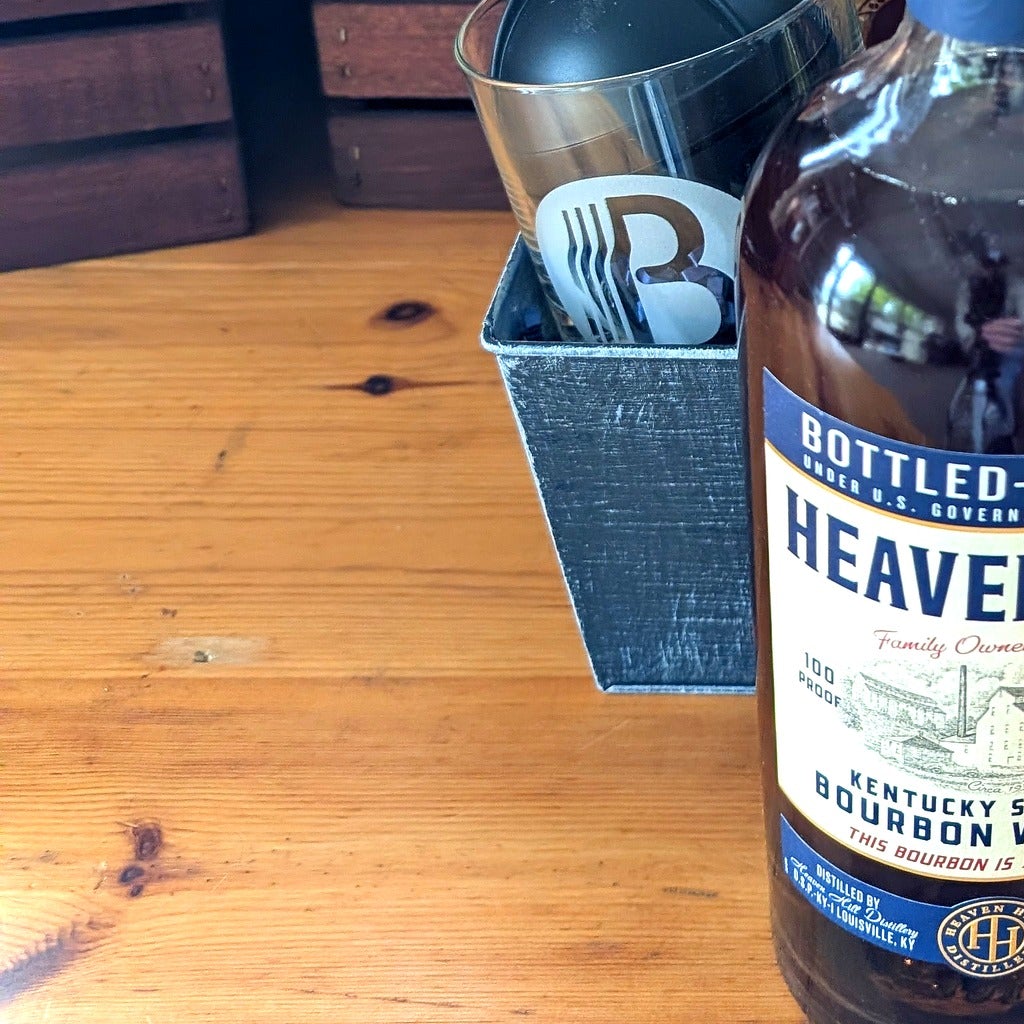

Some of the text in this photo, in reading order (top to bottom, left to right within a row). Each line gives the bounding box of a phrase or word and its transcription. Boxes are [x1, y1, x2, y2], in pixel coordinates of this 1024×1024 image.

[803, 453, 861, 496] UNDER
[872, 487, 917, 513] U.S.
[873, 629, 947, 660] Family
[798, 669, 842, 708] PROOF
[805, 651, 835, 685] 100
[850, 768, 997, 818] KENTUCKY
[967, 780, 1002, 794] Circa
[815, 769, 993, 848] BOURBON
[849, 826, 887, 853] THIS
[894, 846, 988, 872] BOURBON
[994, 857, 1014, 872] IS
[815, 863, 864, 903] DISTILLED
[866, 894, 881, 910] BY
[828, 892, 862, 915] Hill
[864, 907, 920, 939] Distillery
[945, 904, 1005, 937] HEAVEN
[900, 935, 916, 952] KY
